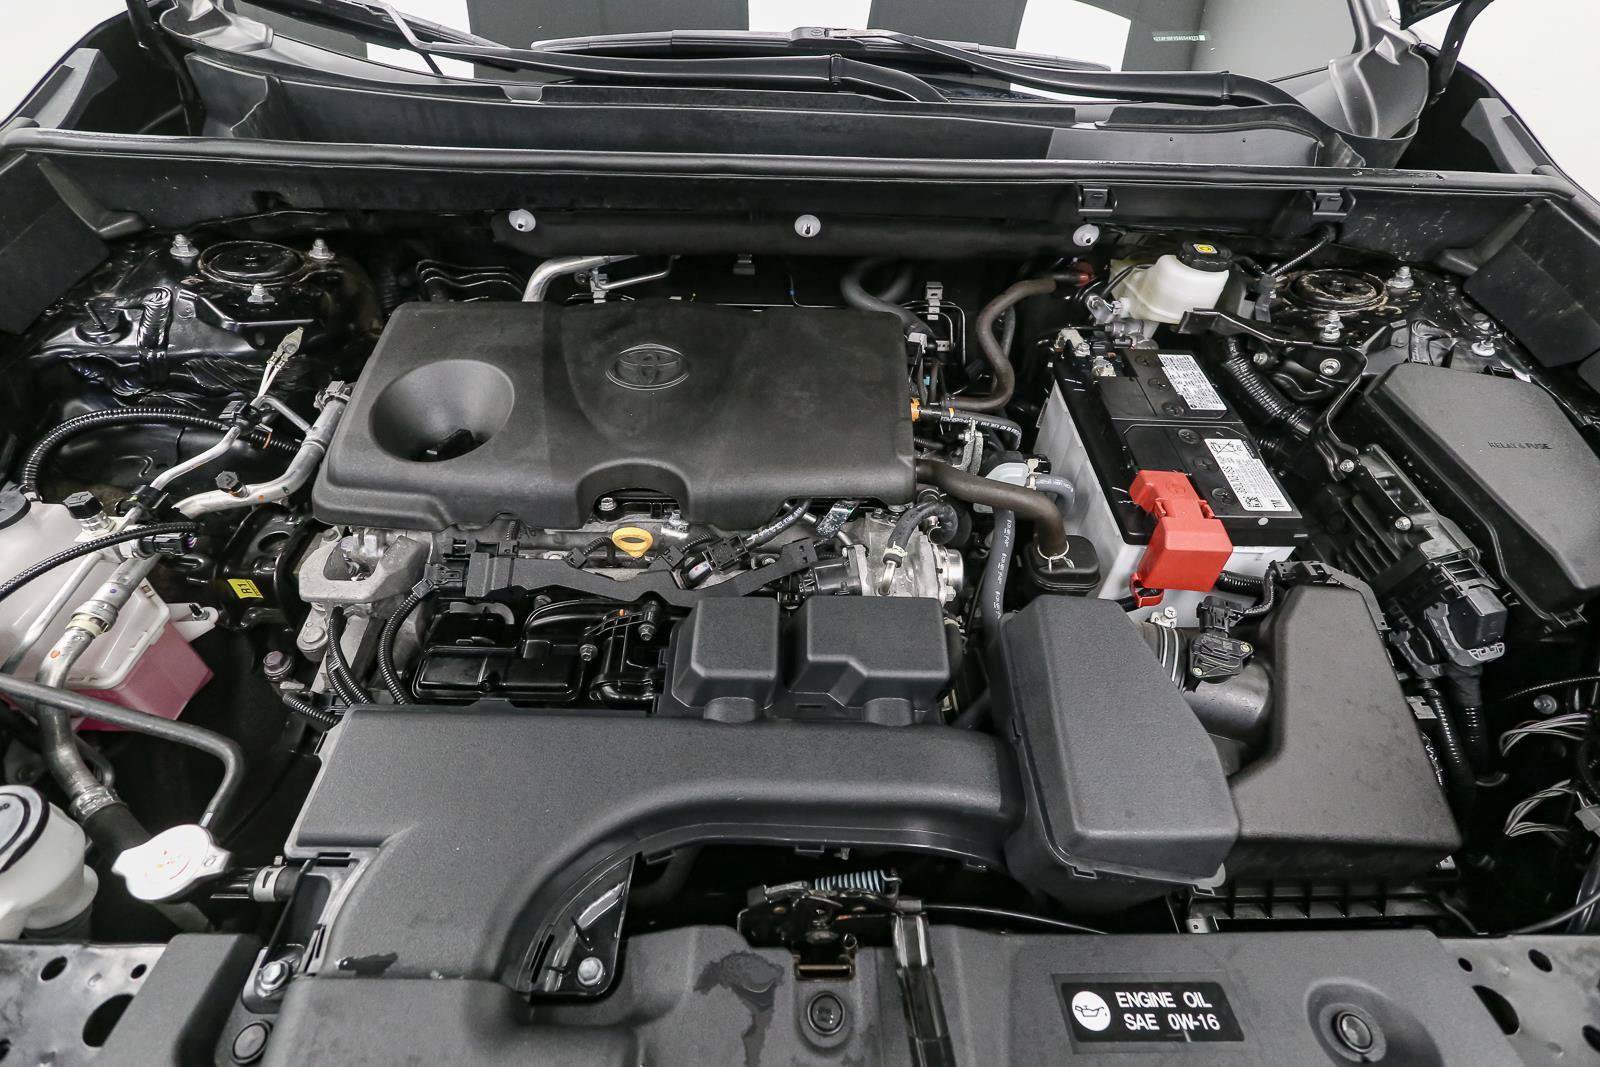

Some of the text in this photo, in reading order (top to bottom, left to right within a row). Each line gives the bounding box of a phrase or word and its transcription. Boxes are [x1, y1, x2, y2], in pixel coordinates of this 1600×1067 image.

[237, 583, 253, 594] R1
[1114, 991, 1213, 1008] ENGINE OIL
[1123, 1013, 1221, 1031] SAE 0W-16
